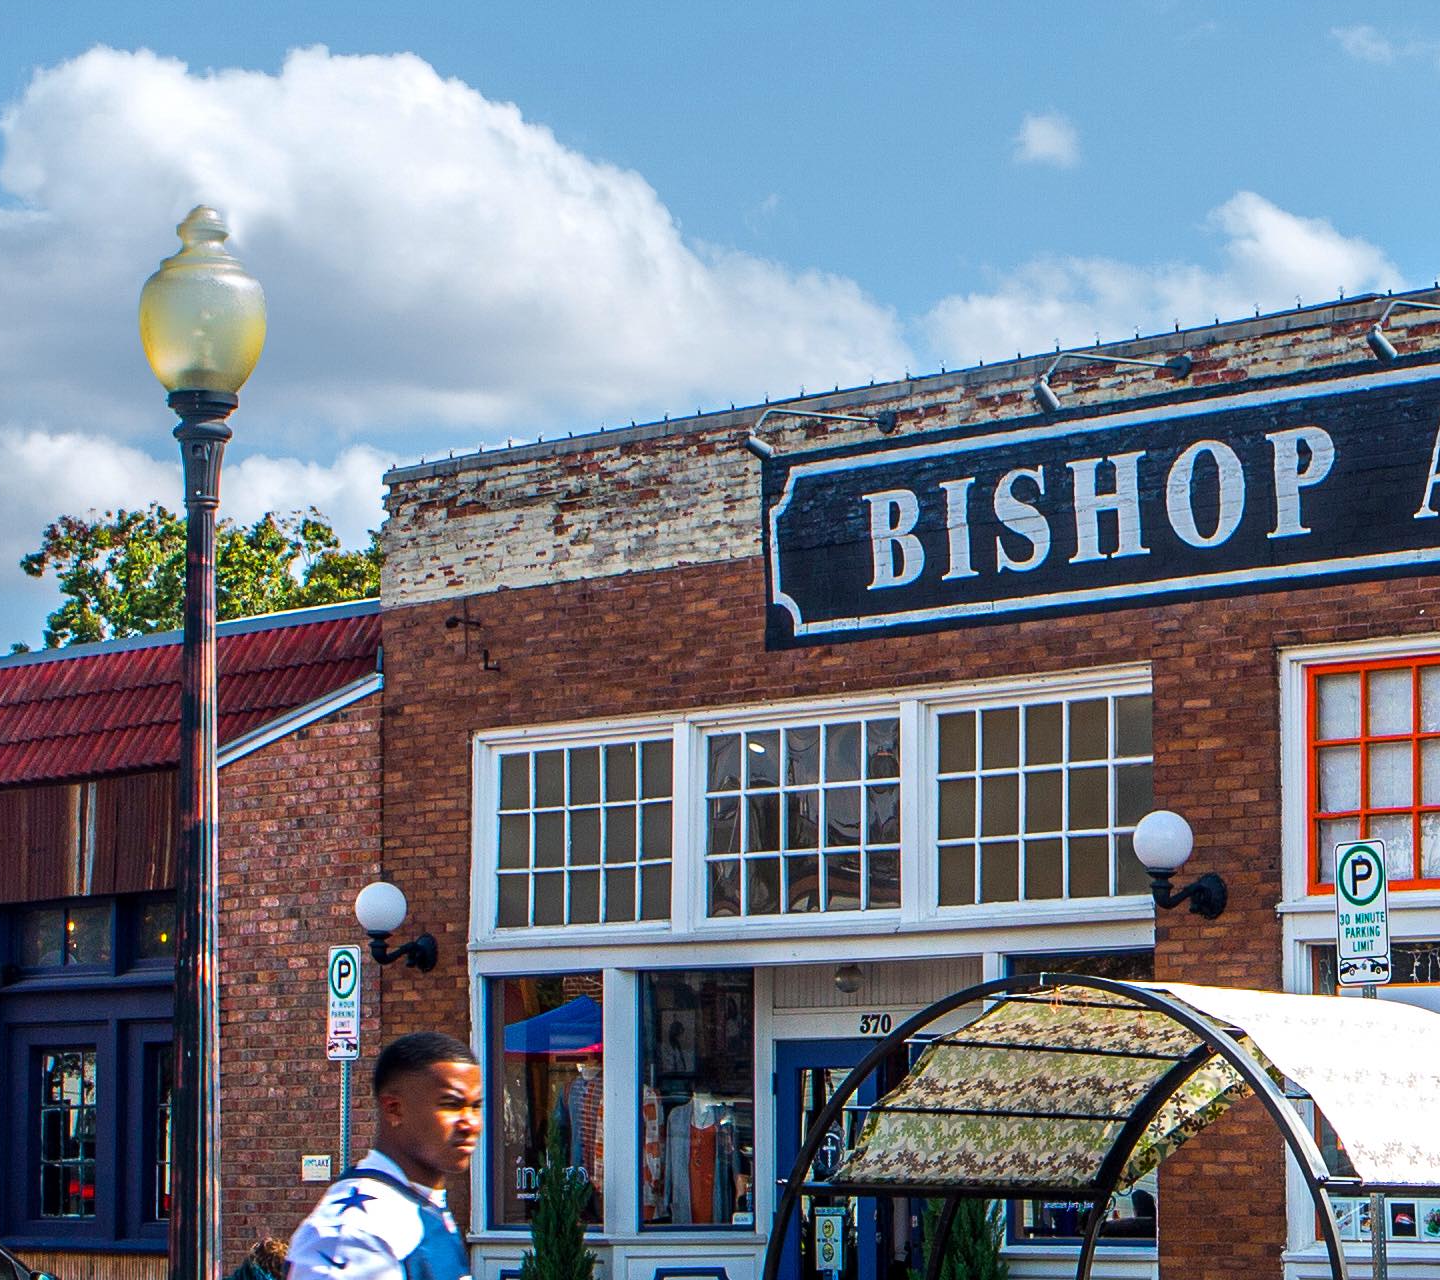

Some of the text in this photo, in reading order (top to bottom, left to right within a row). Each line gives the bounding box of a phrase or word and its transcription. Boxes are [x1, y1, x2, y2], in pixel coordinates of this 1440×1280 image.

[862, 425, 1335, 591] BISHOP
[1351, 858, 1372, 896] P
[1340, 911, 1385, 926] 30 MINUTE
[1345, 925, 1380, 939] PARKING
[1353, 940, 1374, 952] LIMIT
[331, 1010, 355, 1018] PARKING
[859, 1013, 892, 1035] 370
